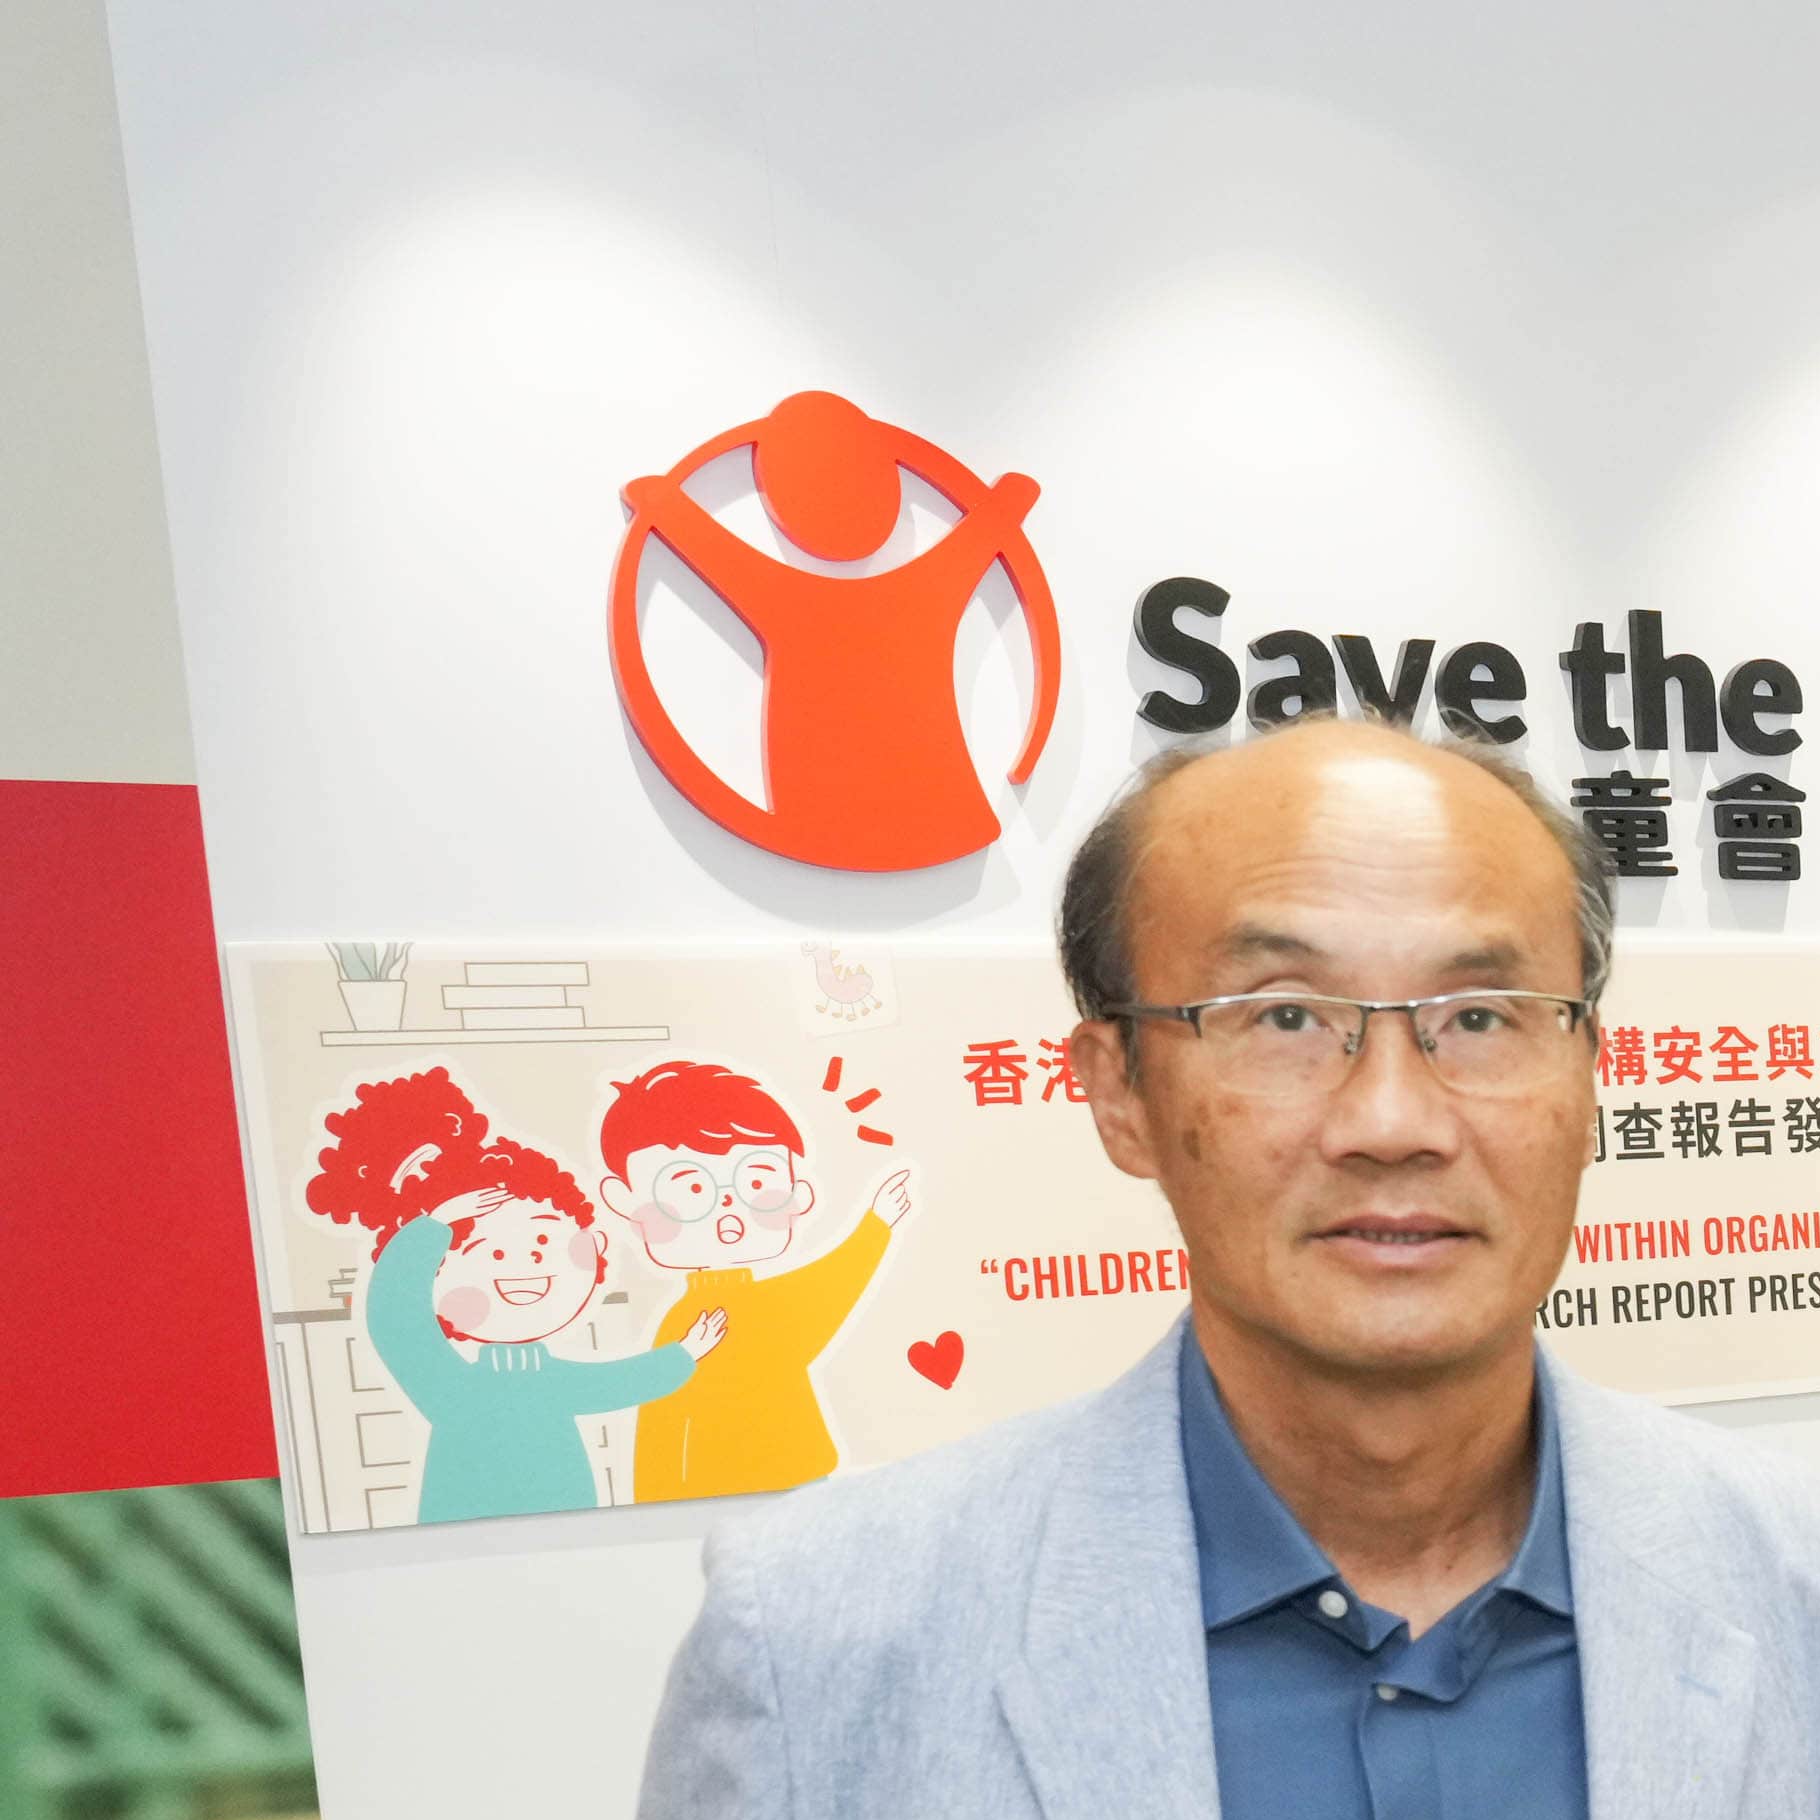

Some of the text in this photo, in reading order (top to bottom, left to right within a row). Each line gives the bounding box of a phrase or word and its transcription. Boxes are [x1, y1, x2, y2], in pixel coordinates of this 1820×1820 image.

[1133, 576, 1528, 744] Save
[1559, 609, 1804, 756] the
[1570, 770, 1807, 881] 童會
[1574, 1219, 1690, 1263] WITHIN
[1612, 1277, 1735, 1324] REPORT
